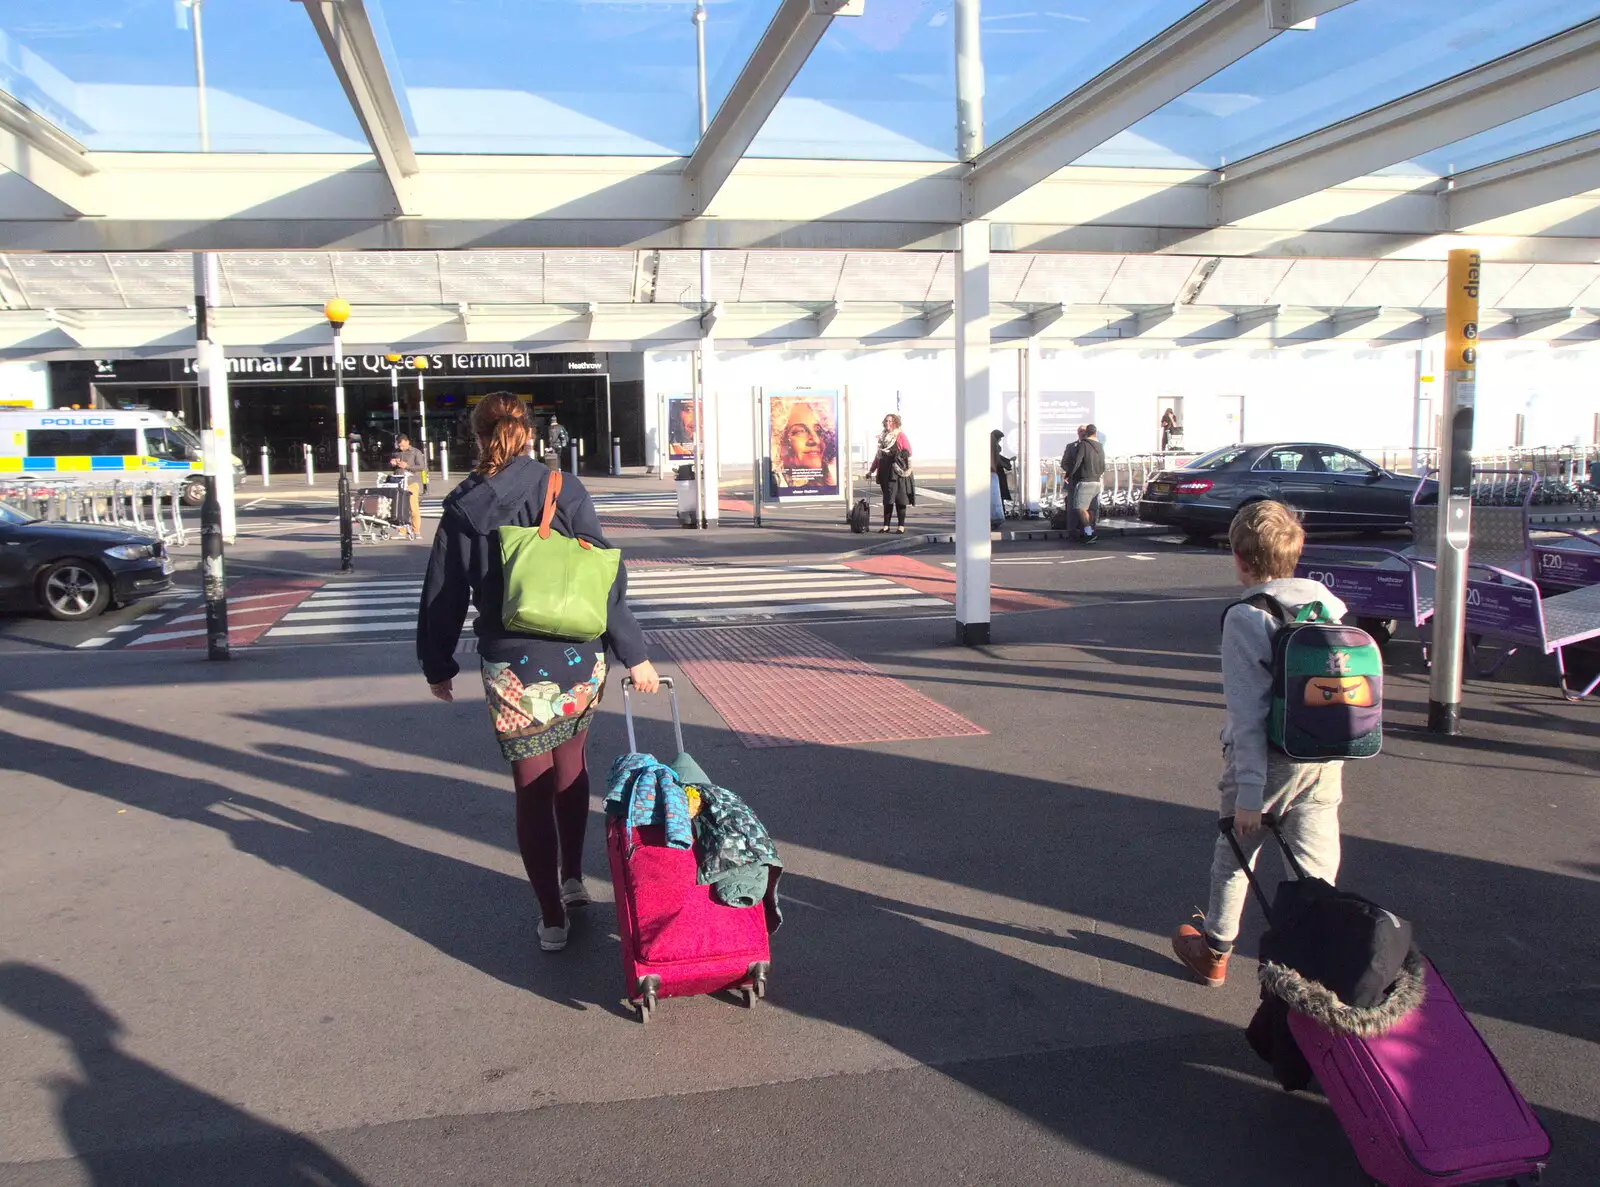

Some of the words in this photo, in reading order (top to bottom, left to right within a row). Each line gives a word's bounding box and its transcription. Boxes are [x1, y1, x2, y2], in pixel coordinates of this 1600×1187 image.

[288, 356, 303, 371] 2
[452, 353, 530, 369] Terminal
[568, 362, 602, 370] Heathrow
[41, 418, 115, 426] POLICE
[1543, 554, 1562, 569] £20
[1307, 571, 1335, 588] £20
[1466, 588, 1480, 606] 20
